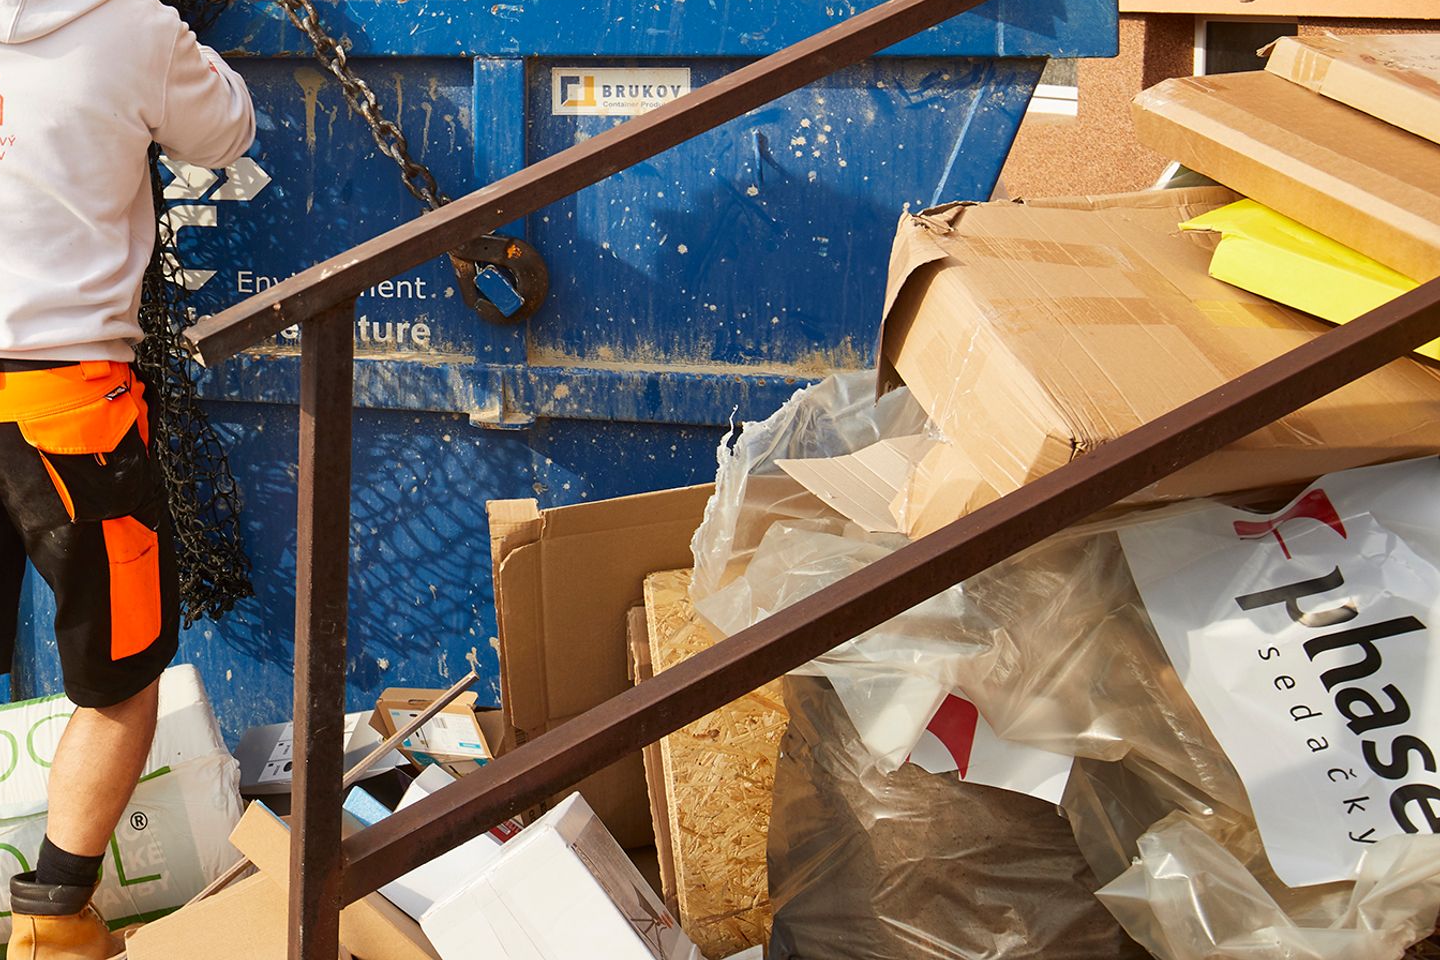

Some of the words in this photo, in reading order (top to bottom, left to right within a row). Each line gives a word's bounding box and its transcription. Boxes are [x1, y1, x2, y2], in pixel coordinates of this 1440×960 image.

[602, 85, 681, 98] BRUKOV
[1235, 565, 1440, 835] phase
[1258, 646, 1378, 844] sedačky
